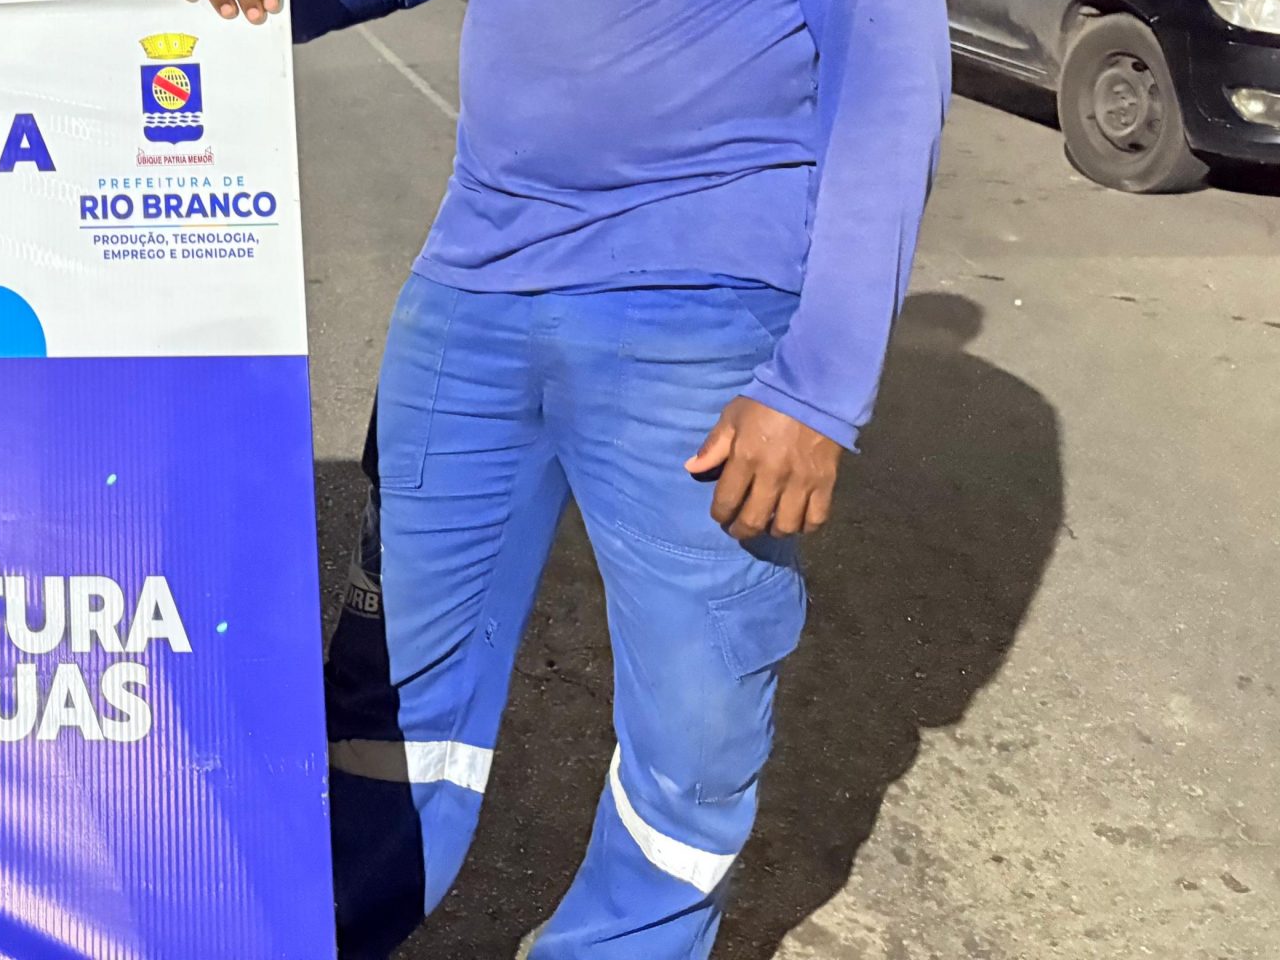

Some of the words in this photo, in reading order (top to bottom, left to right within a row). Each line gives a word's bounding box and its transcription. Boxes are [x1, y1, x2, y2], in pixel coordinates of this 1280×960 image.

[137, 156, 162, 165] UBIQUE
[164, 156, 187, 164] PATRIA
[188, 155, 213, 164] MEMOR
[98, 176, 212, 189] PREFEITURA
[223, 175, 245, 187] DE
[80, 194, 134, 220] RIO
[142, 191, 277, 219] BRANCO
[93, 232, 169, 246] PRODUÇÃO,
[172, 232, 260, 245] TECNOLOGIA,
[103, 249, 165, 260] EMPREGO
[170, 249, 177, 259] E
[181, 248, 254, 259] DIGNIDADE
